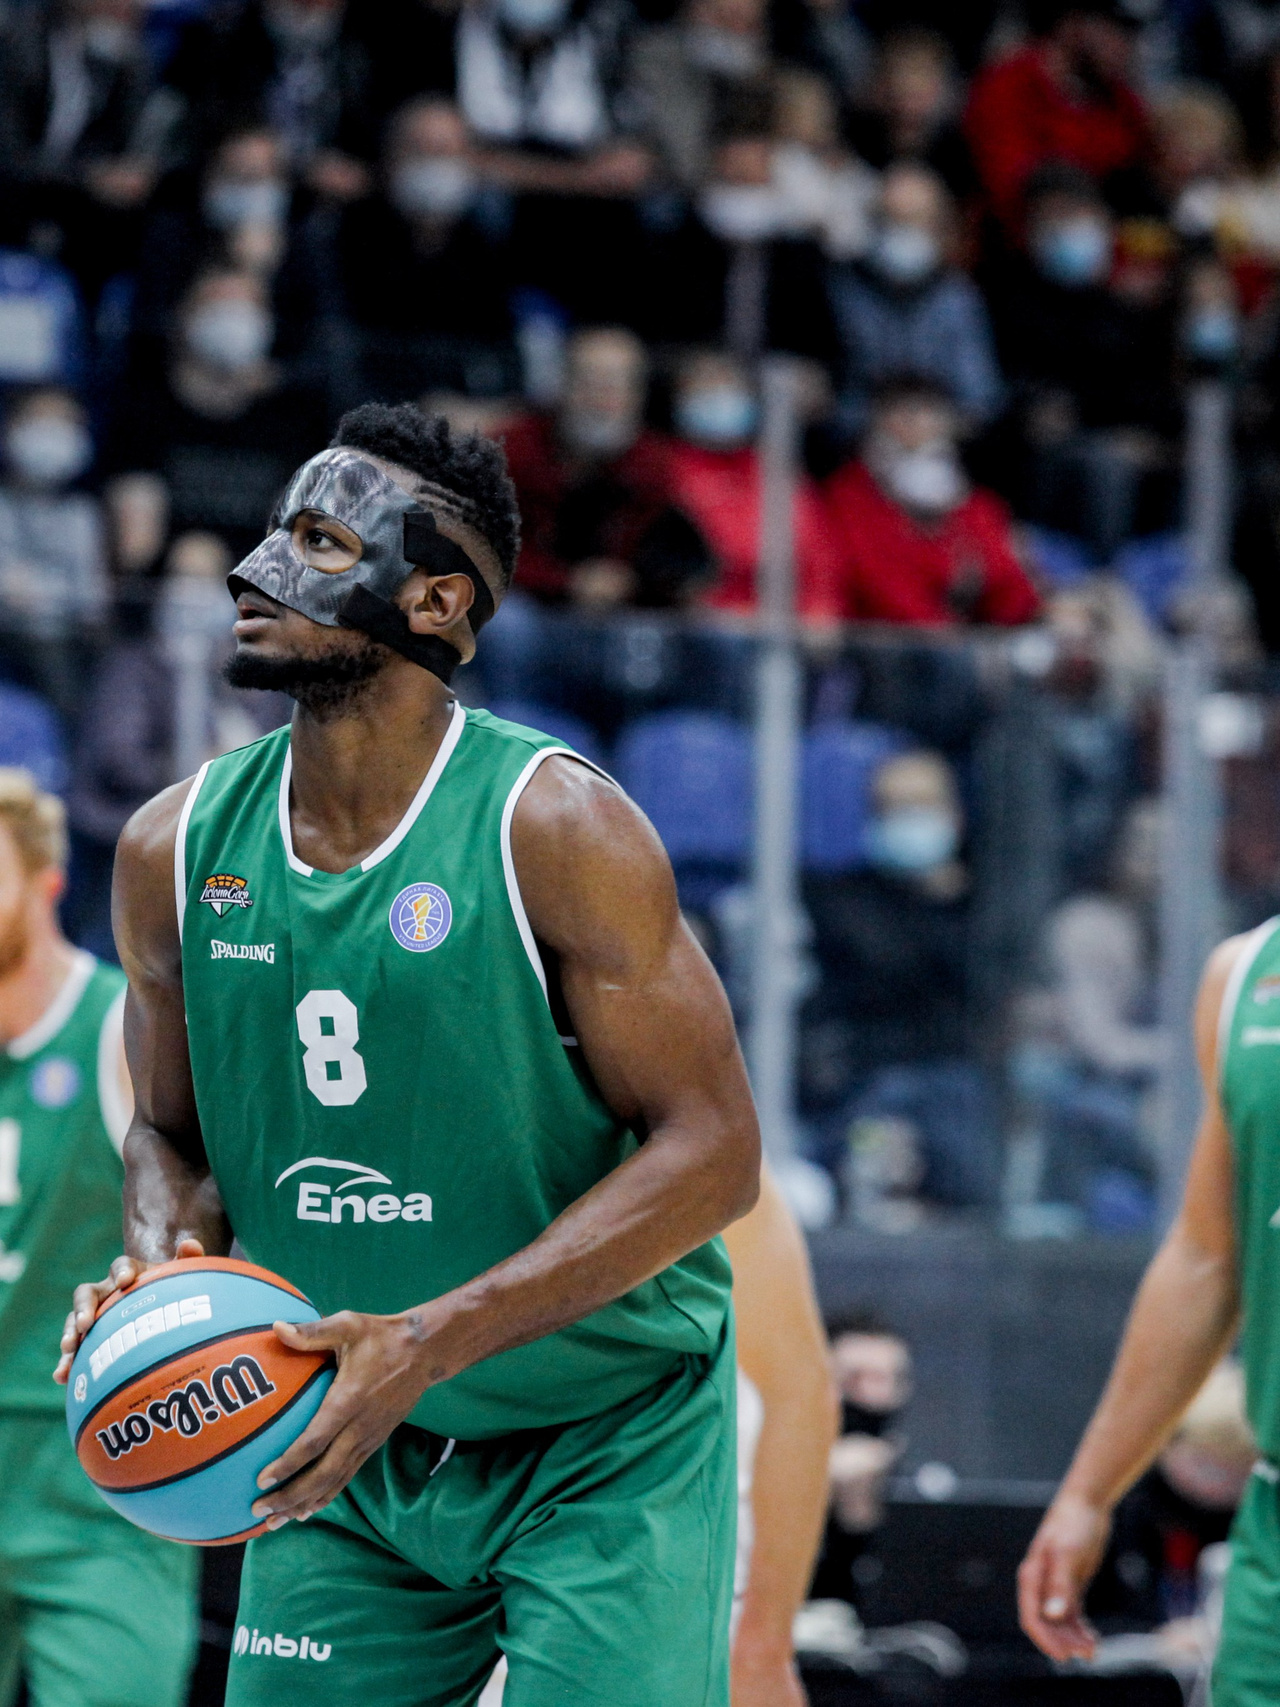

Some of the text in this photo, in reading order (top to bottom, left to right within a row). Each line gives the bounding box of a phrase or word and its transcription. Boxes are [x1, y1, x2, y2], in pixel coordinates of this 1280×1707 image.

[210, 939, 275, 965] SPALDING
[295, 989, 368, 1107] 8
[296, 1182, 433, 1224] Enea
[88, 1294, 213, 1381] SIBUR
[95, 1353, 277, 1461] Wilson
[249, 1628, 332, 1662] inblu
